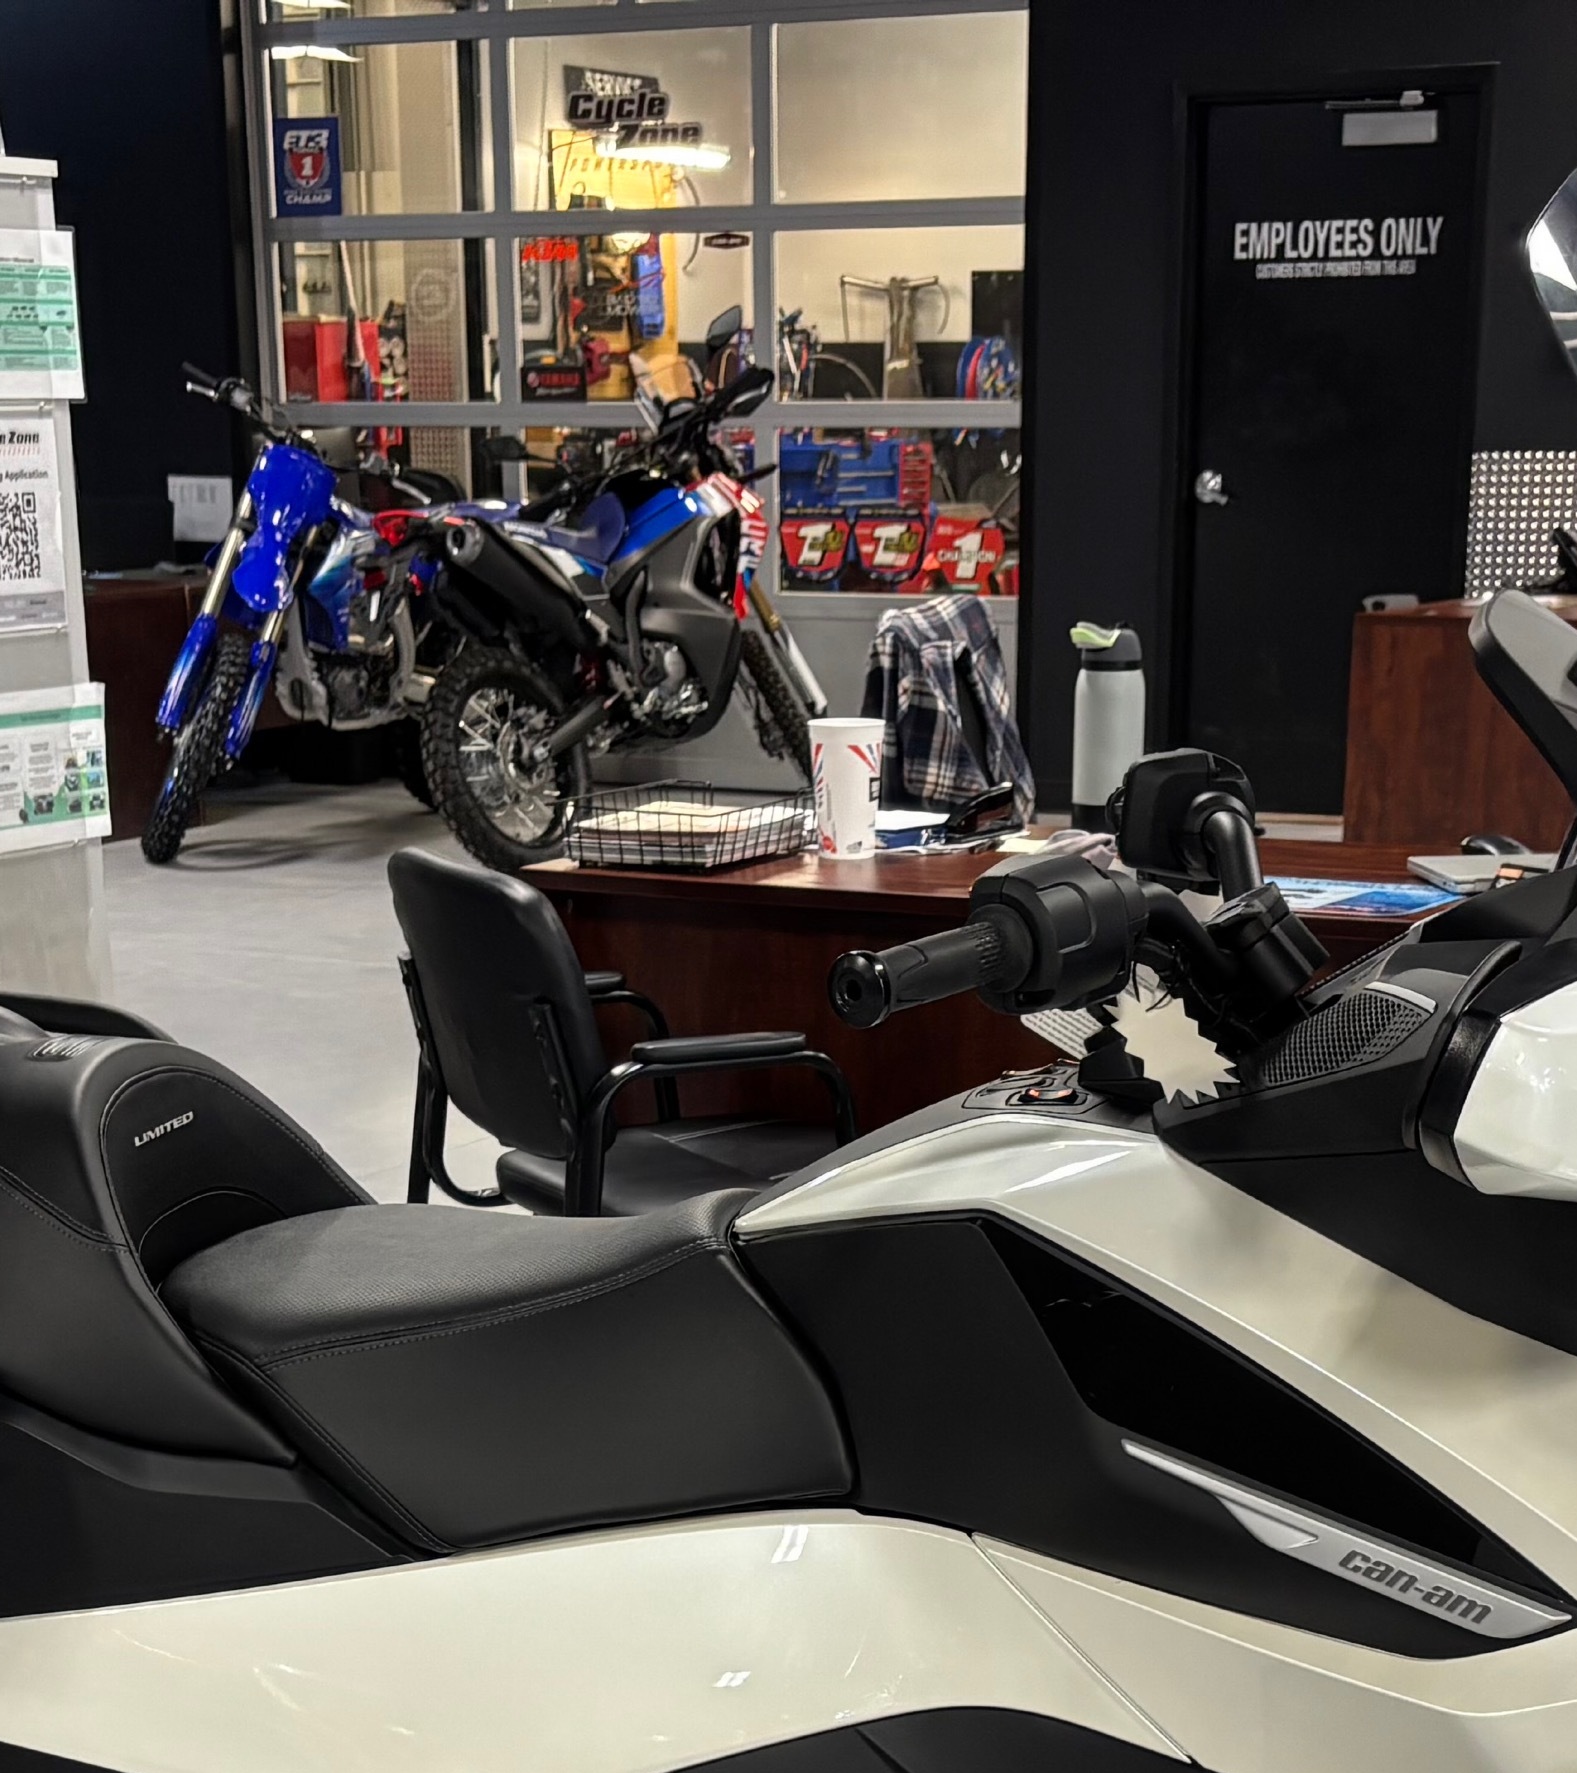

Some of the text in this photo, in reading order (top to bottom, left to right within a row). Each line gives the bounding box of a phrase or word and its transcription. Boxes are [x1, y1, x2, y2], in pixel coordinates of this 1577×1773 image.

[569, 92, 667, 124] Cycle
[301, 155, 313, 176] 1
[1234, 216, 1444, 259] EMPLOYEES ONLY
[8, 432, 39, 444] Zone
[5, 469, 48, 482] Application
[134, 1111, 194, 1147] LIMITED
[1337, 1549, 1492, 1625] can-am
